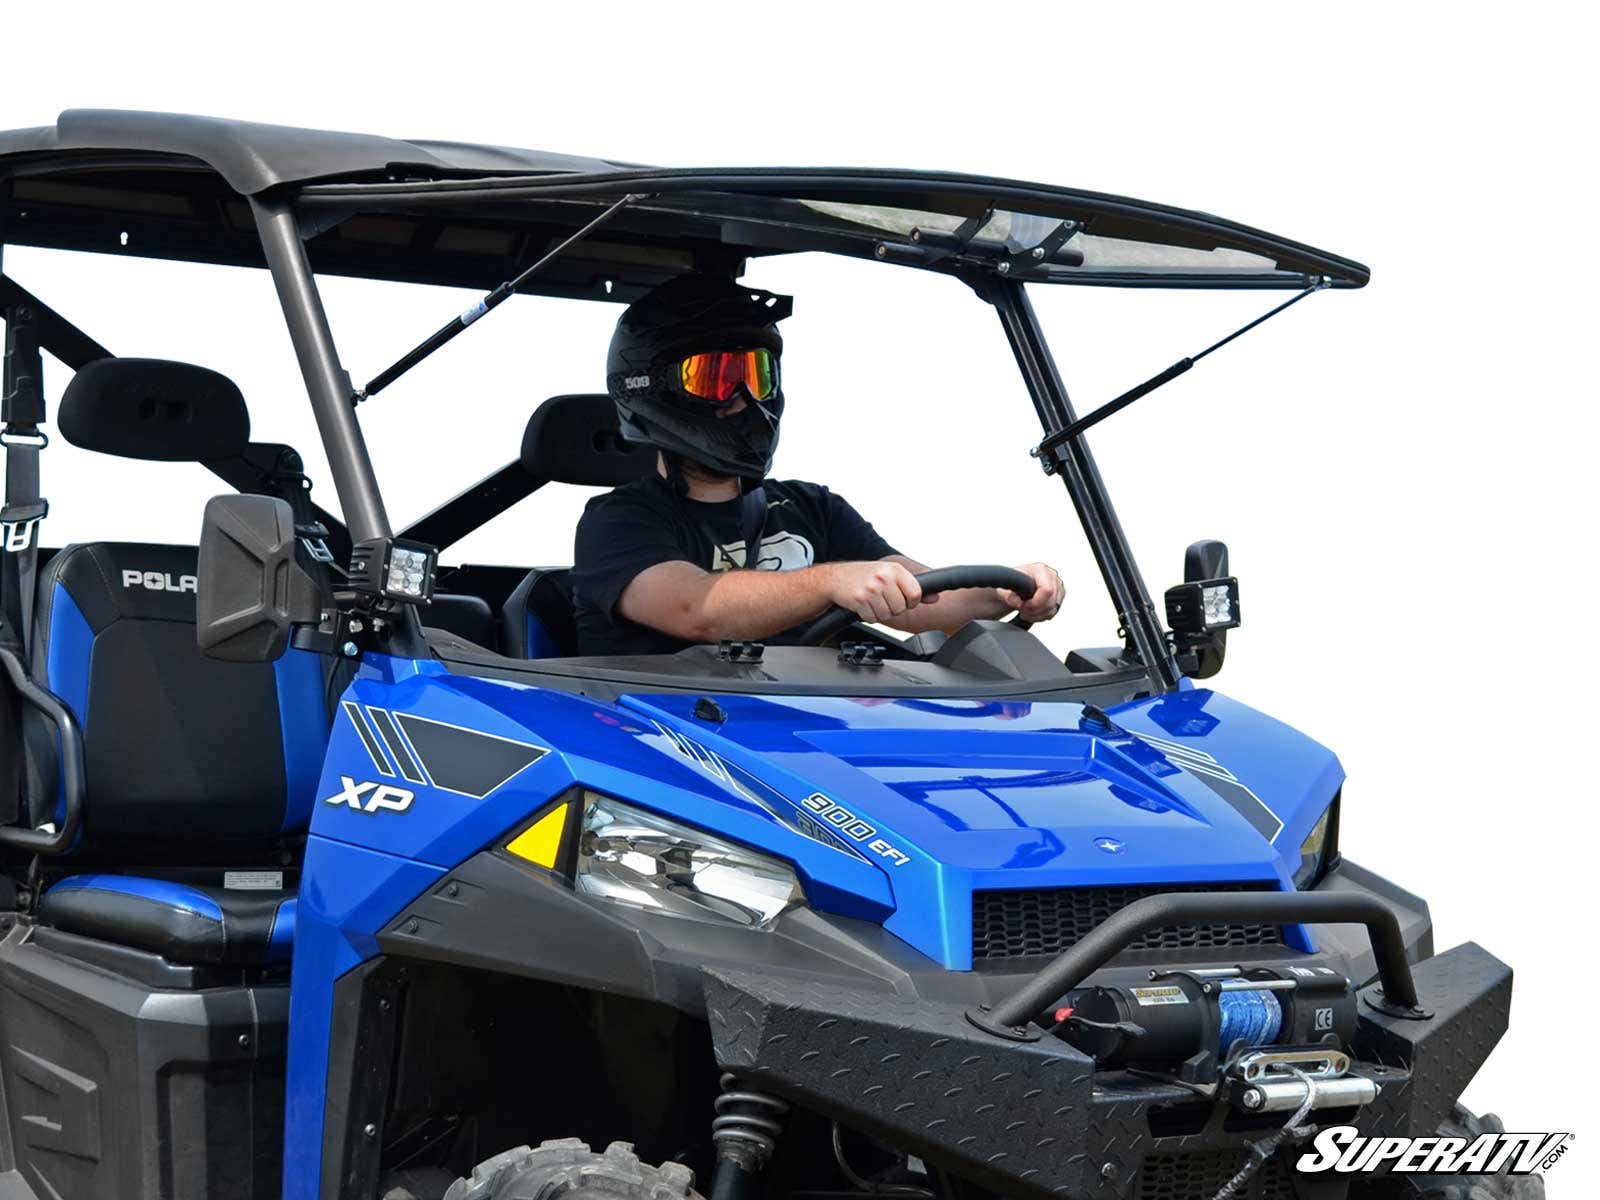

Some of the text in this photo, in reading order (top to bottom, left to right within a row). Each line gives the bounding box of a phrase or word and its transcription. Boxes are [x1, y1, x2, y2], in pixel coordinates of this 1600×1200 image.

[625, 375, 650, 389] 509
[325, 776, 415, 812] XP
[801, 792, 877, 842] 900
[867, 839, 911, 866] EFI
